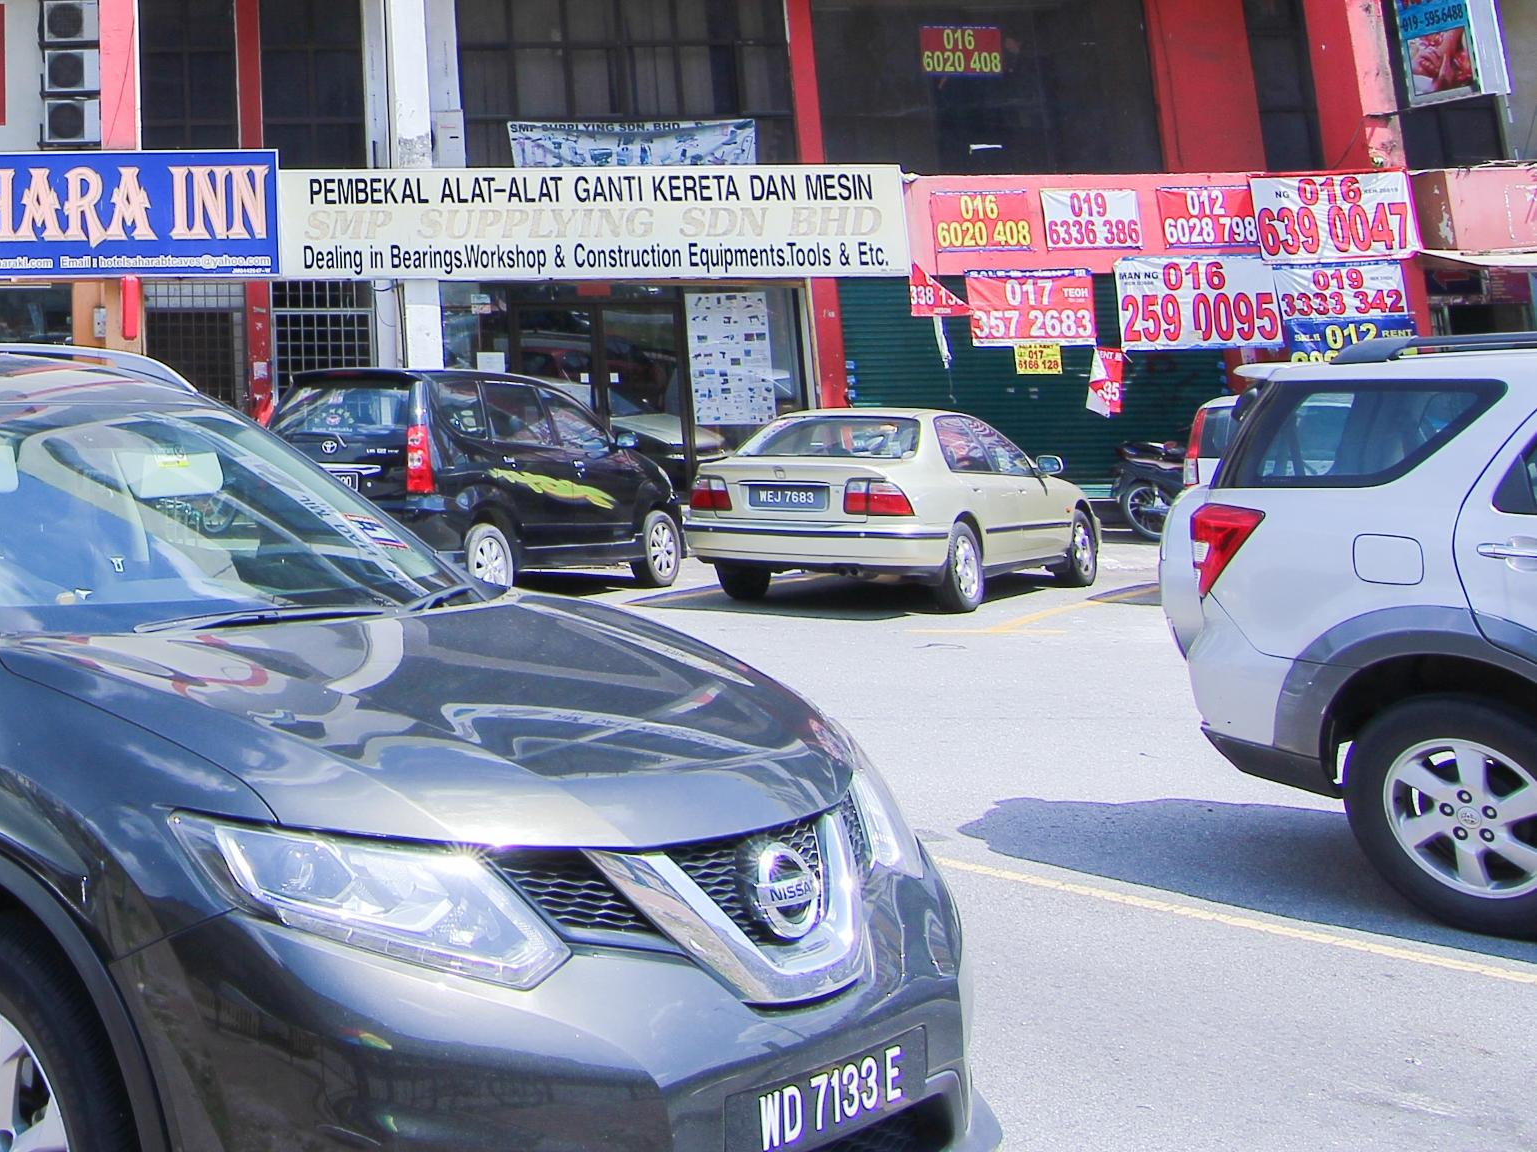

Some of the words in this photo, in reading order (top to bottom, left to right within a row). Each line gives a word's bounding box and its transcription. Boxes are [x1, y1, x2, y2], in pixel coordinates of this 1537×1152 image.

[944, 29, 975, 49] 016
[924, 51, 964, 71] 6020
[970, 51, 1001, 72] 408
[309, 177, 429, 204] PEMBEKAL
[441, 176, 562, 203] ALAT-ALAT
[574, 175, 643, 202] GANTI
[652, 175, 740, 202] KERETA
[750, 174, 796, 201] DAN
[805, 174, 873, 201] MESIN
[1275, 191, 1290, 199] NG
[1298, 176, 1361, 205] 016
[167, 165, 270, 241] INN
[960, 195, 999, 220] 016
[1070, 193, 1108, 217] 019
[1186, 191, 1226, 215] 012
[304, 209, 392, 241] SMP
[417, 207, 654, 240] SUPPLYING
[679, 206, 769, 238] SDN
[789, 206, 882, 237] BHD
[937, 221, 988, 247] 6020
[993, 220, 1032, 246] 408
[1048, 220, 1097, 245] 6336
[1103, 219, 1140, 245] 386
[1164, 217, 1214, 244] 6028
[1220, 216, 1257, 242] 798
[1258, 206, 1320, 256] 639
[1328, 202, 1408, 252] 0047
[60, 256, 91, 268] Email
[303, 245, 363, 275] Dealing
[370, 245, 384, 269] in
[555, 244, 566, 268] &
[574, 243, 681, 268] Construction
[839, 242, 850, 266] &
[859, 242, 889, 266] Etc.
[1144, 271, 1158, 279] NG
[1163, 262, 1226, 291] 016
[1313, 268, 1363, 290] 019
[1005, 279, 1053, 306] 017
[1281, 292, 1346, 316] 3333
[1354, 289, 1404, 314] 342
[973, 310, 1020, 337] 357
[1028, 309, 1092, 337] 2683
[1122, 294, 1181, 343] 259
[1193, 292, 1278, 342] 0095
[1325, 323, 1377, 349] 012
[1382, 329, 1413, 338] RENT
[759, 490, 781, 502] WEJ
[784, 491, 814, 503] 7683
[759, 1085, 804, 1151] WD
[810, 1056, 878, 1131] 7133
[885, 1046, 902, 1102] E
